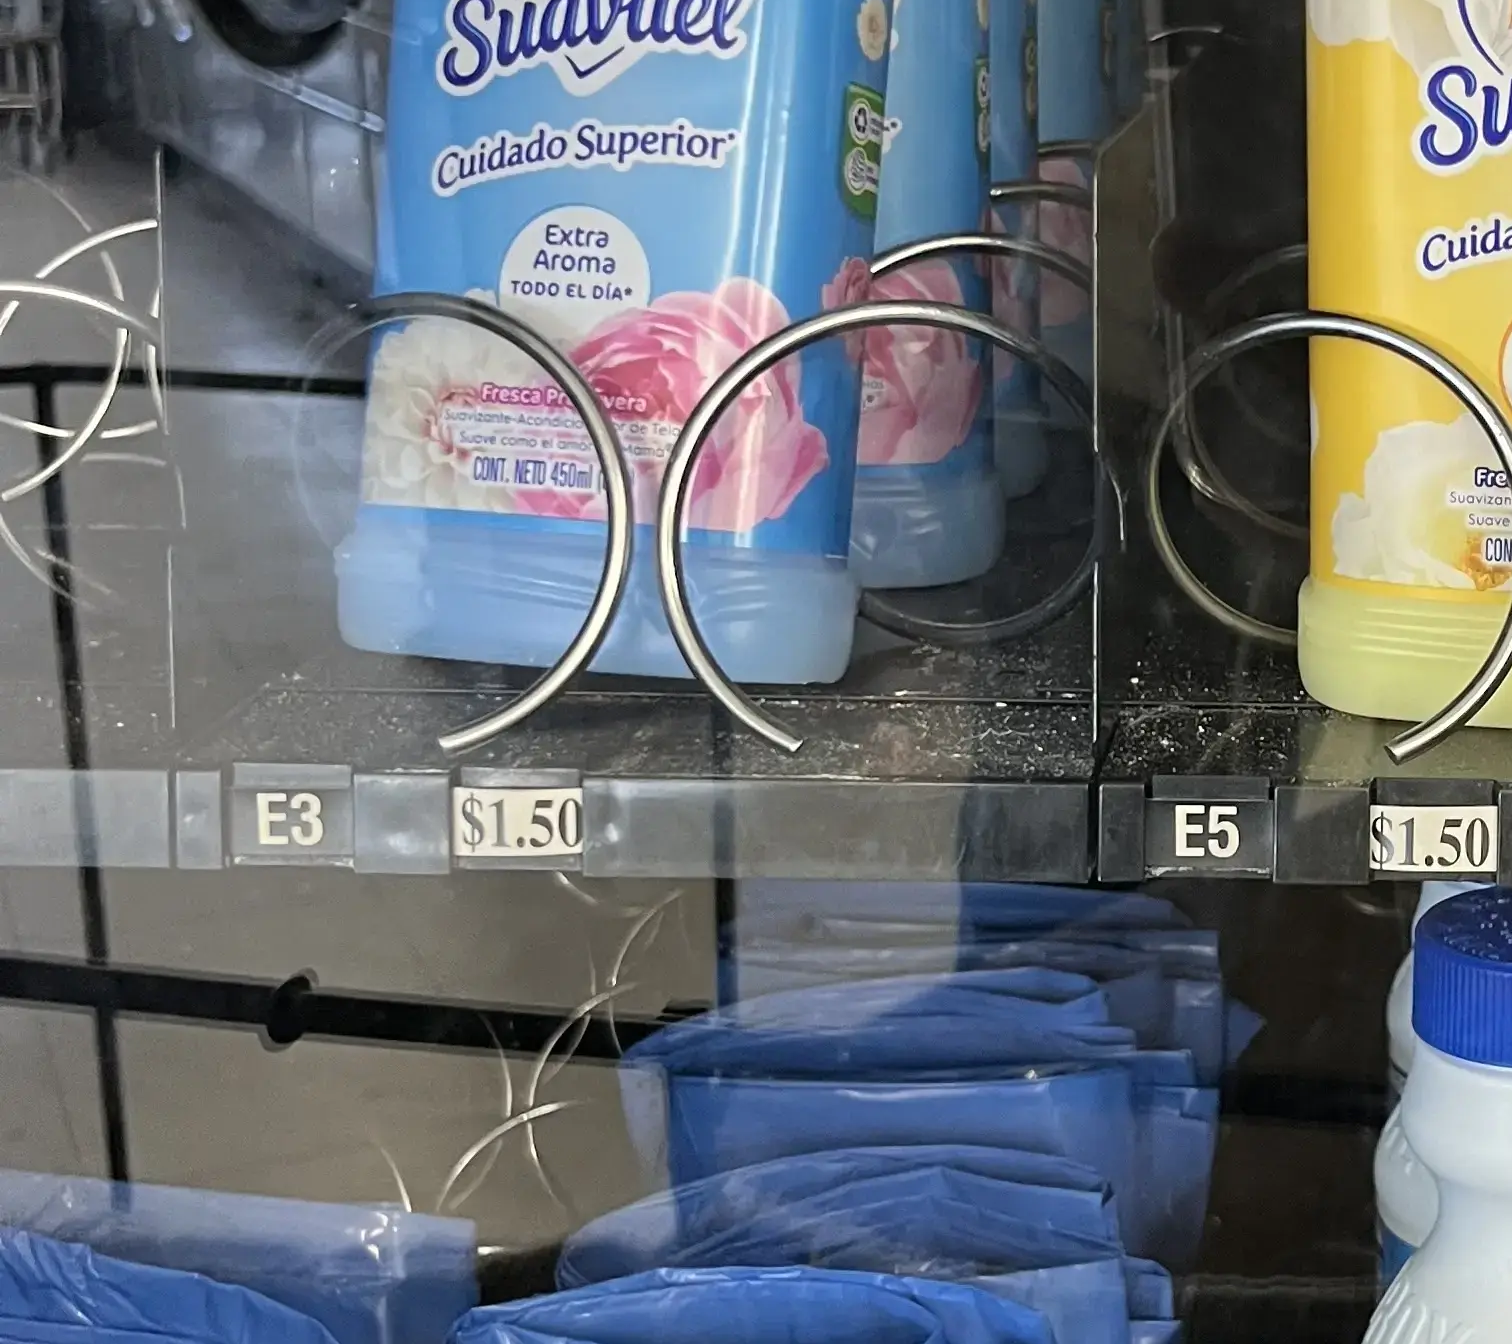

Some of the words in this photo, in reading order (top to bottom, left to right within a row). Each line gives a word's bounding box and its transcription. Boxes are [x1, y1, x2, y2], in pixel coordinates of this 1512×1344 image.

[435, 133, 567, 189] Cuidado
[545, 224, 610, 249] Extra
[533, 249, 616, 275] Aroma
[510, 280, 562, 298] TODO
[566, 282, 587, 298] EL
[481, 383, 542, 405] Fresca
[546, 388, 647, 413] Prvera
[459, 431, 496, 445] Suave
[500, 434, 538, 448] como
[541, 434, 554, 448] el
[629, 423, 648, 434] de
[651, 422, 682, 437] Tela
[473, 455, 510, 484] CONT.
[513, 458, 546, 486] NETO
[550, 460, 594, 489] 450ml
[1468, 513, 1511, 528] Suave
[256, 792, 324, 846] E3
[461, 792, 583, 854] $1.50
[1174, 804, 1241, 858] E5
[1370, 811, 1491, 870] $1.50
